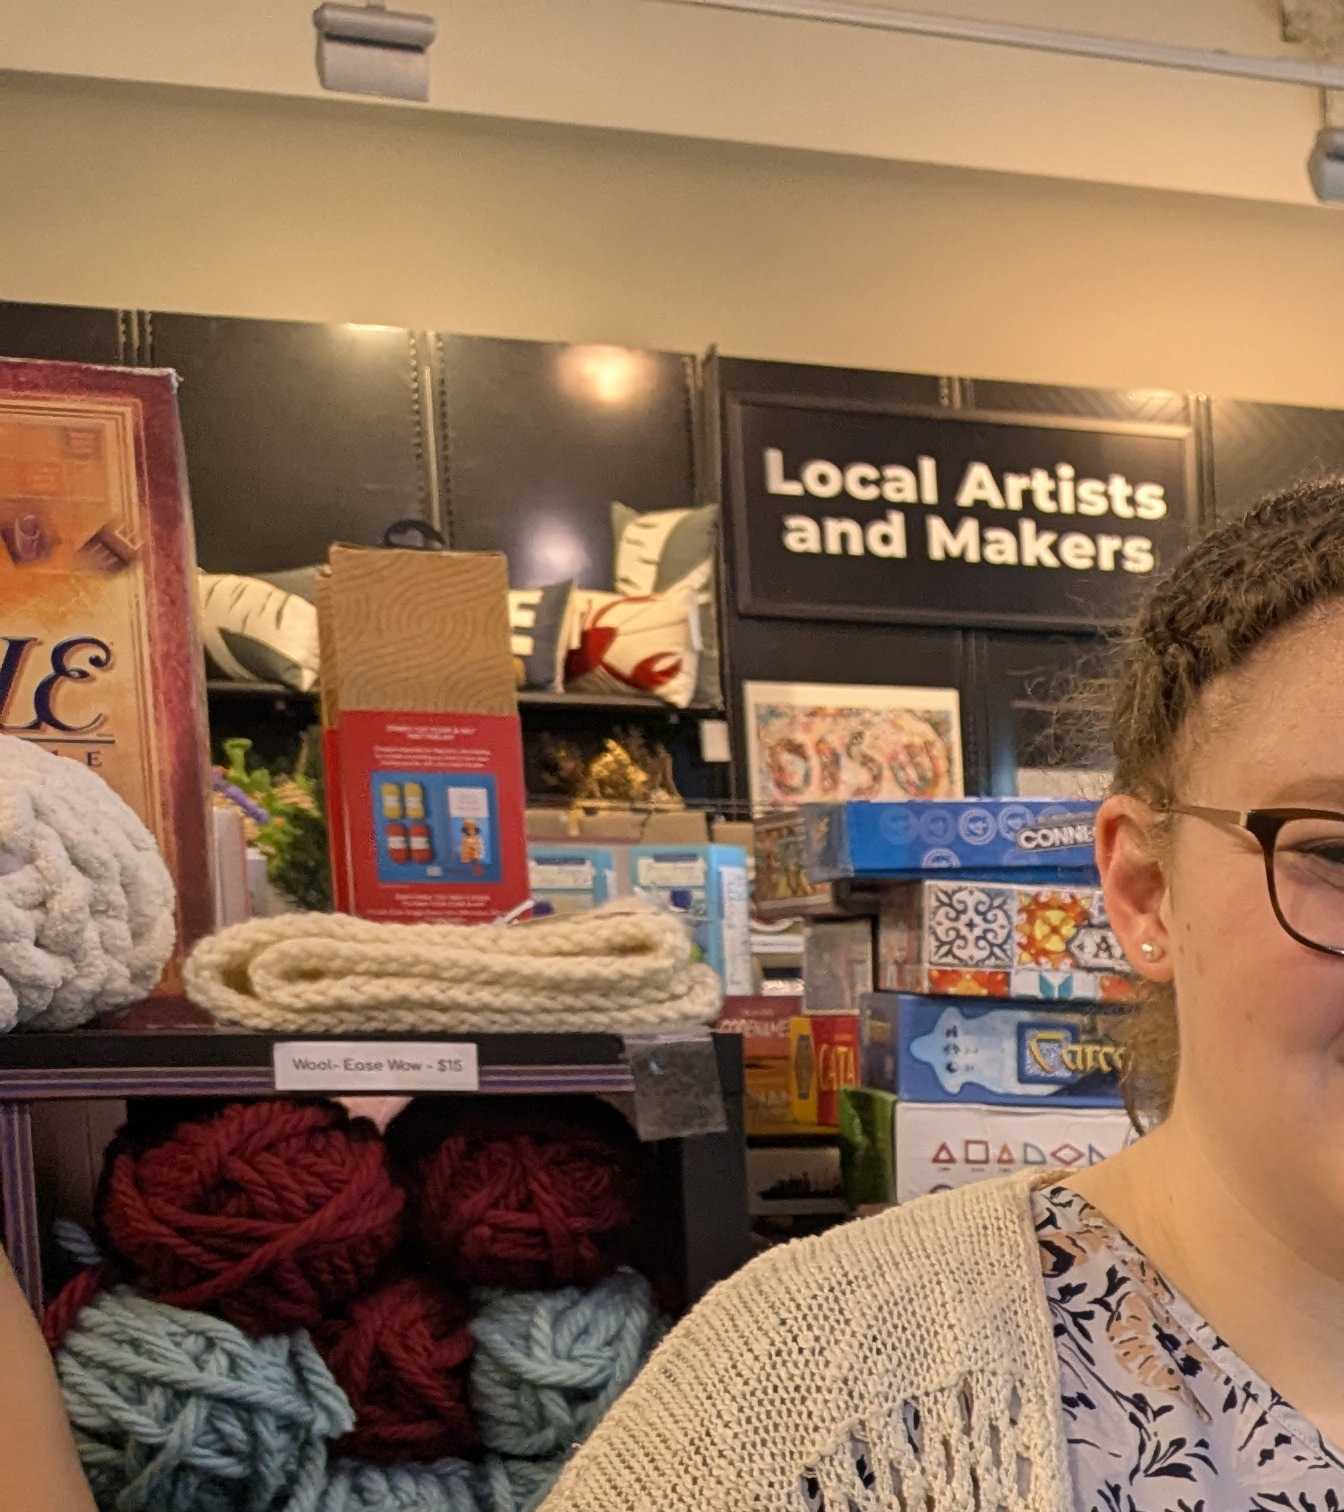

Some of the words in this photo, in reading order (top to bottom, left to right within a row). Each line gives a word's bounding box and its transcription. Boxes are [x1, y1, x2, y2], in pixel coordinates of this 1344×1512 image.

[763, 447, 939, 506] Local
[955, 461, 1168, 521] Artists
[782, 509, 908, 559] and
[926, 514, 1155, 574] Makers
[343, 1058, 384, 1072] Ease
[387, 1058, 422, 1071] Wow
[437, 1058, 463, 1073] $15
